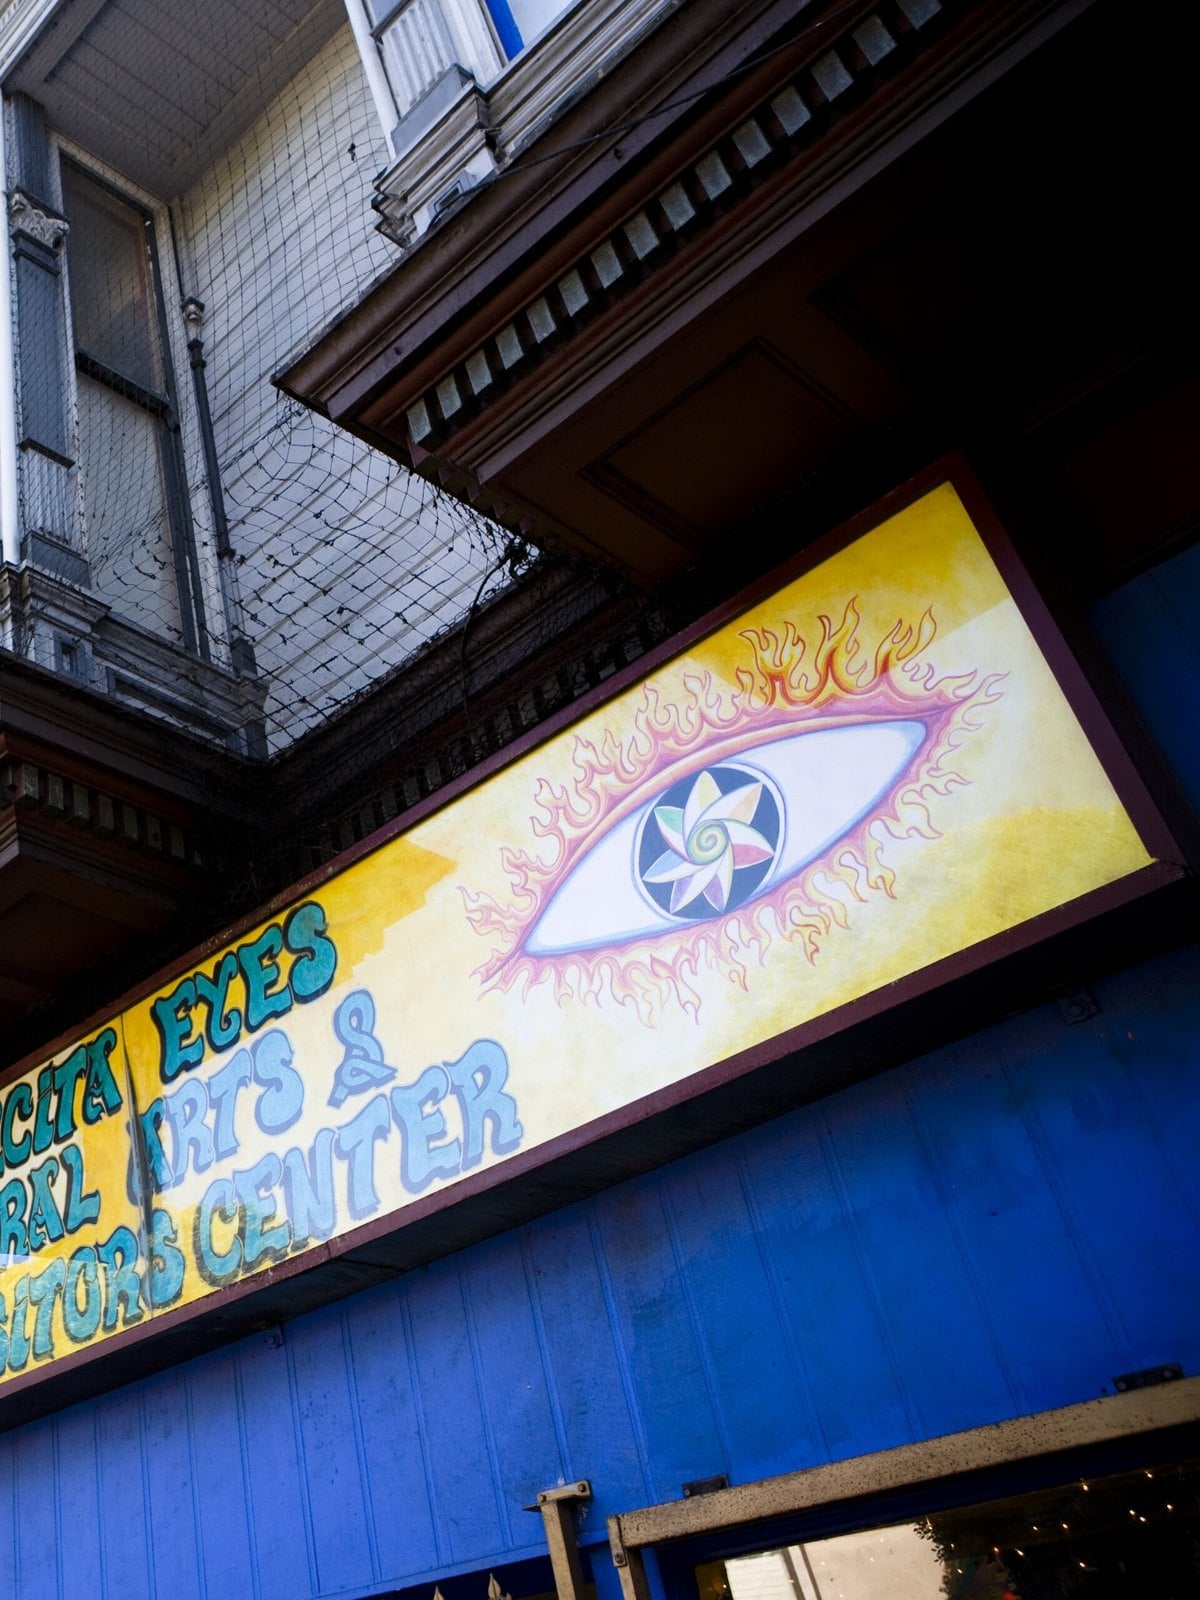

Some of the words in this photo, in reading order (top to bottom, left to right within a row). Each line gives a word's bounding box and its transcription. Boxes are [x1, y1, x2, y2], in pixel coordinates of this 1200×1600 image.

[126, 1027, 305, 1206] ARTS
[327, 989, 398, 1108] &
[151, 900, 338, 1084] EYES
[194, 1038, 523, 1288] CENTER
